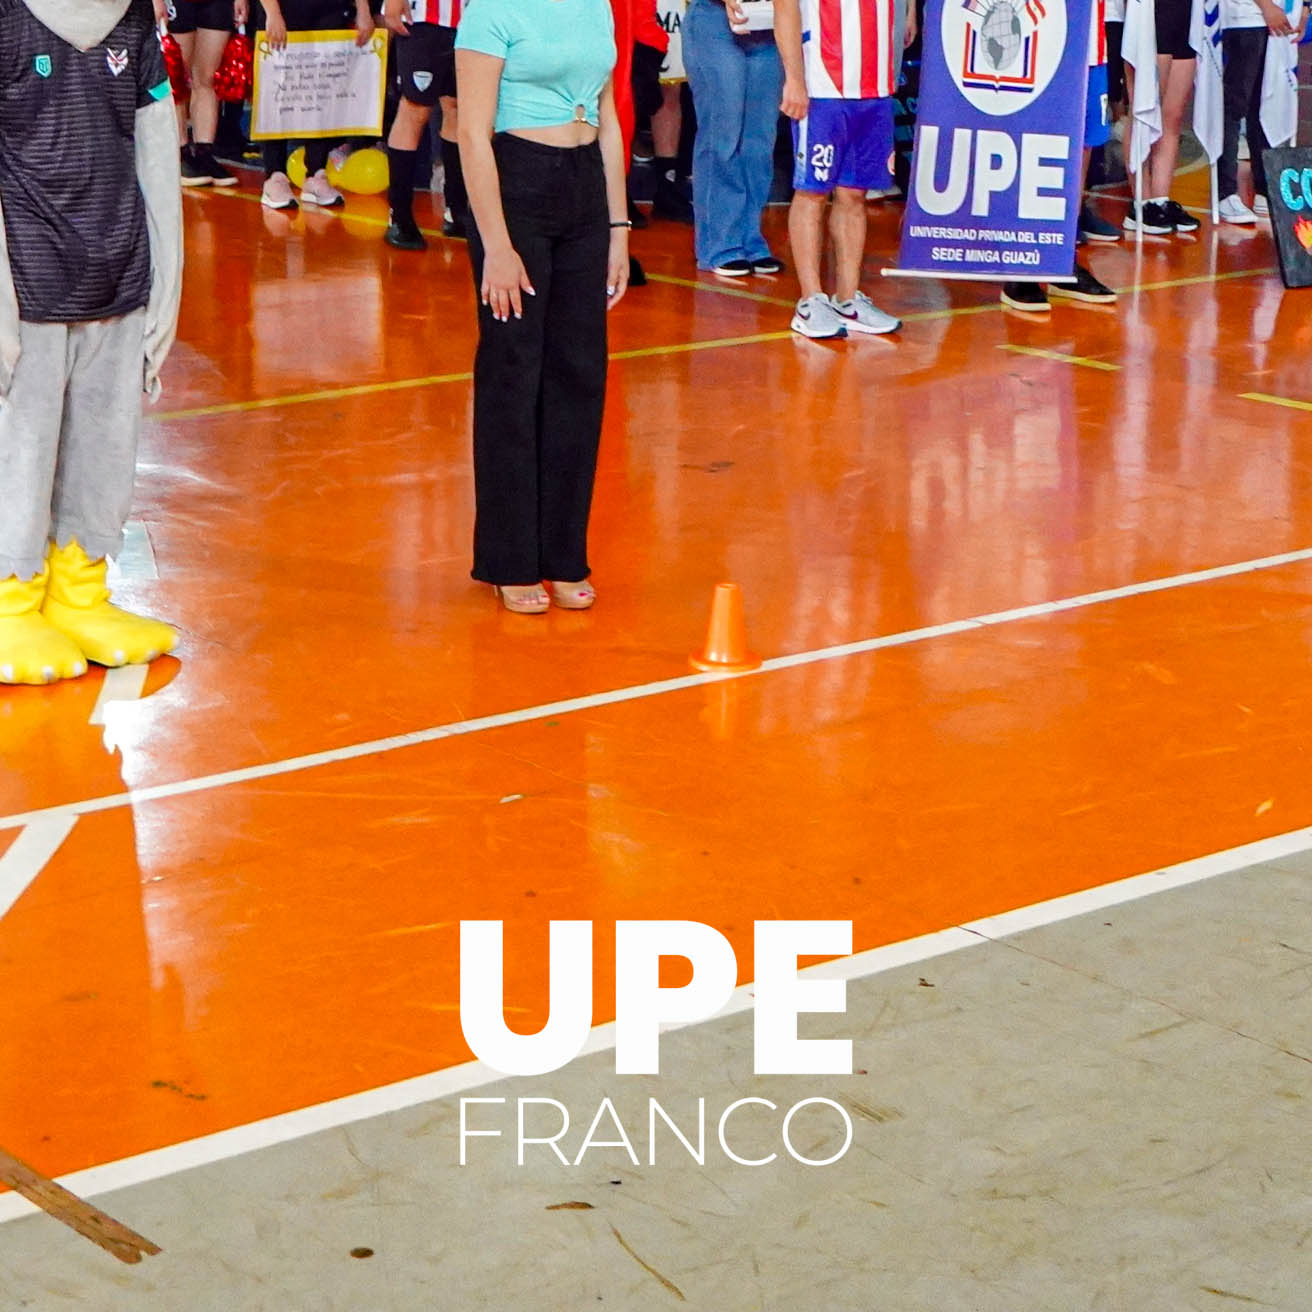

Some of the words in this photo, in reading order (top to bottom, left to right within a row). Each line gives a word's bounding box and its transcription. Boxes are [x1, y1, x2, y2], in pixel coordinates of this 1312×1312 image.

[811, 143, 834, 167] 20
[915, 125, 1070, 221] UPE
[910, 225, 977, 241] UNIVERSIDAD
[978, 229, 1017, 243] PRIVADA
[1017, 232, 1037, 244] DEL
[1038, 233, 1064, 245] ESTE
[931, 247, 963, 261] SEDE
[965, 249, 1000, 263] MINGA
[1002, 249, 1041, 265] GUAZÚ
